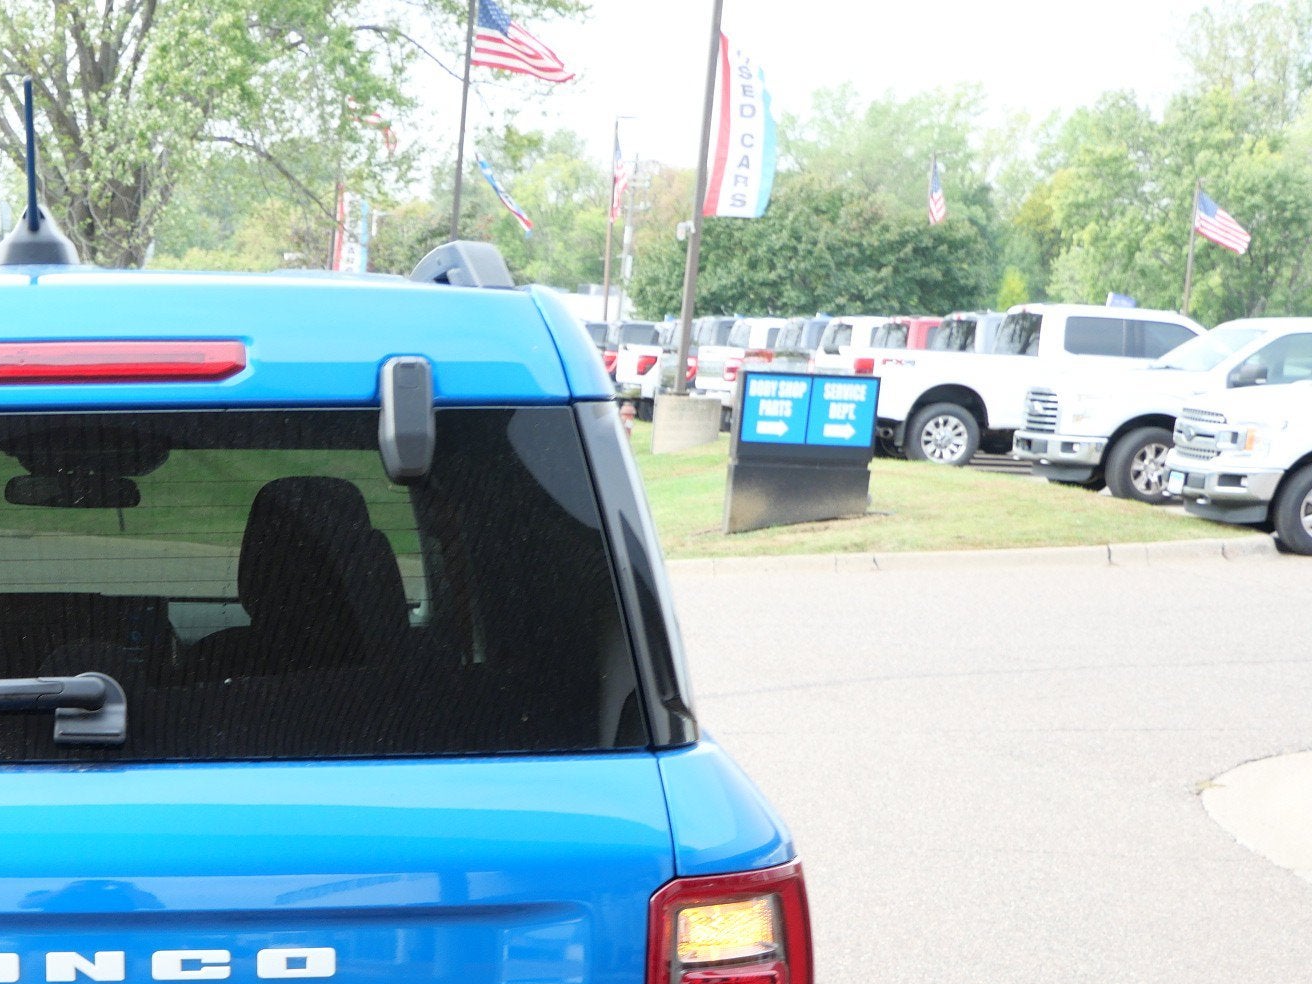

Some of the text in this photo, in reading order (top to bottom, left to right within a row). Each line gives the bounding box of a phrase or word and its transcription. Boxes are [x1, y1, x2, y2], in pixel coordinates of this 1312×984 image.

[729, 133, 755, 208] CARS
[748, 379, 807, 399] BODY SHOP
[823, 382, 867, 401] SERVICE
[758, 399, 793, 417] PARTS
